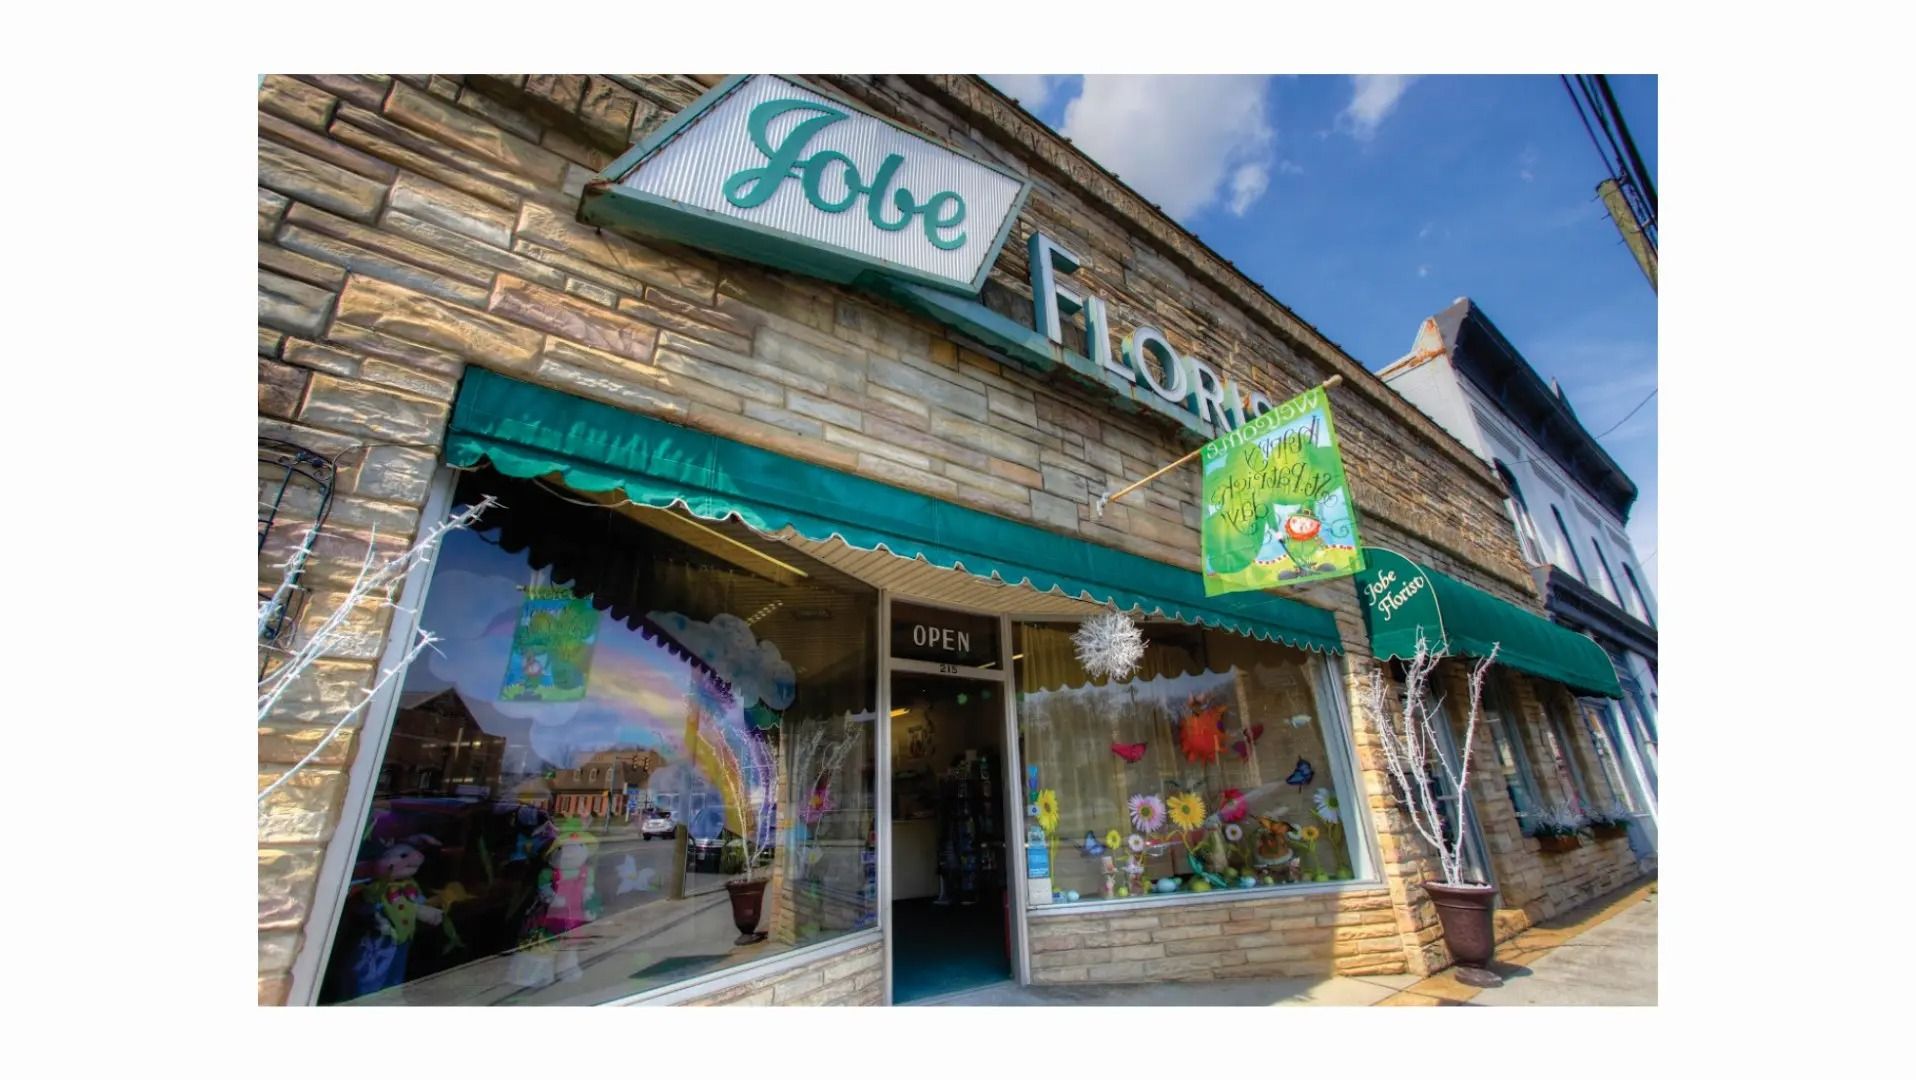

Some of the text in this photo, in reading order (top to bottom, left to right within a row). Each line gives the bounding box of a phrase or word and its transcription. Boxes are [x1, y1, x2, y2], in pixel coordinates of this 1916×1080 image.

[722, 98, 968, 251] Jobe
[1363, 569, 1397, 607] Jobe
[1378, 575, 1424, 622] Florist
[913, 624, 970, 653] OPEN
[939, 664, 958, 674] 215
